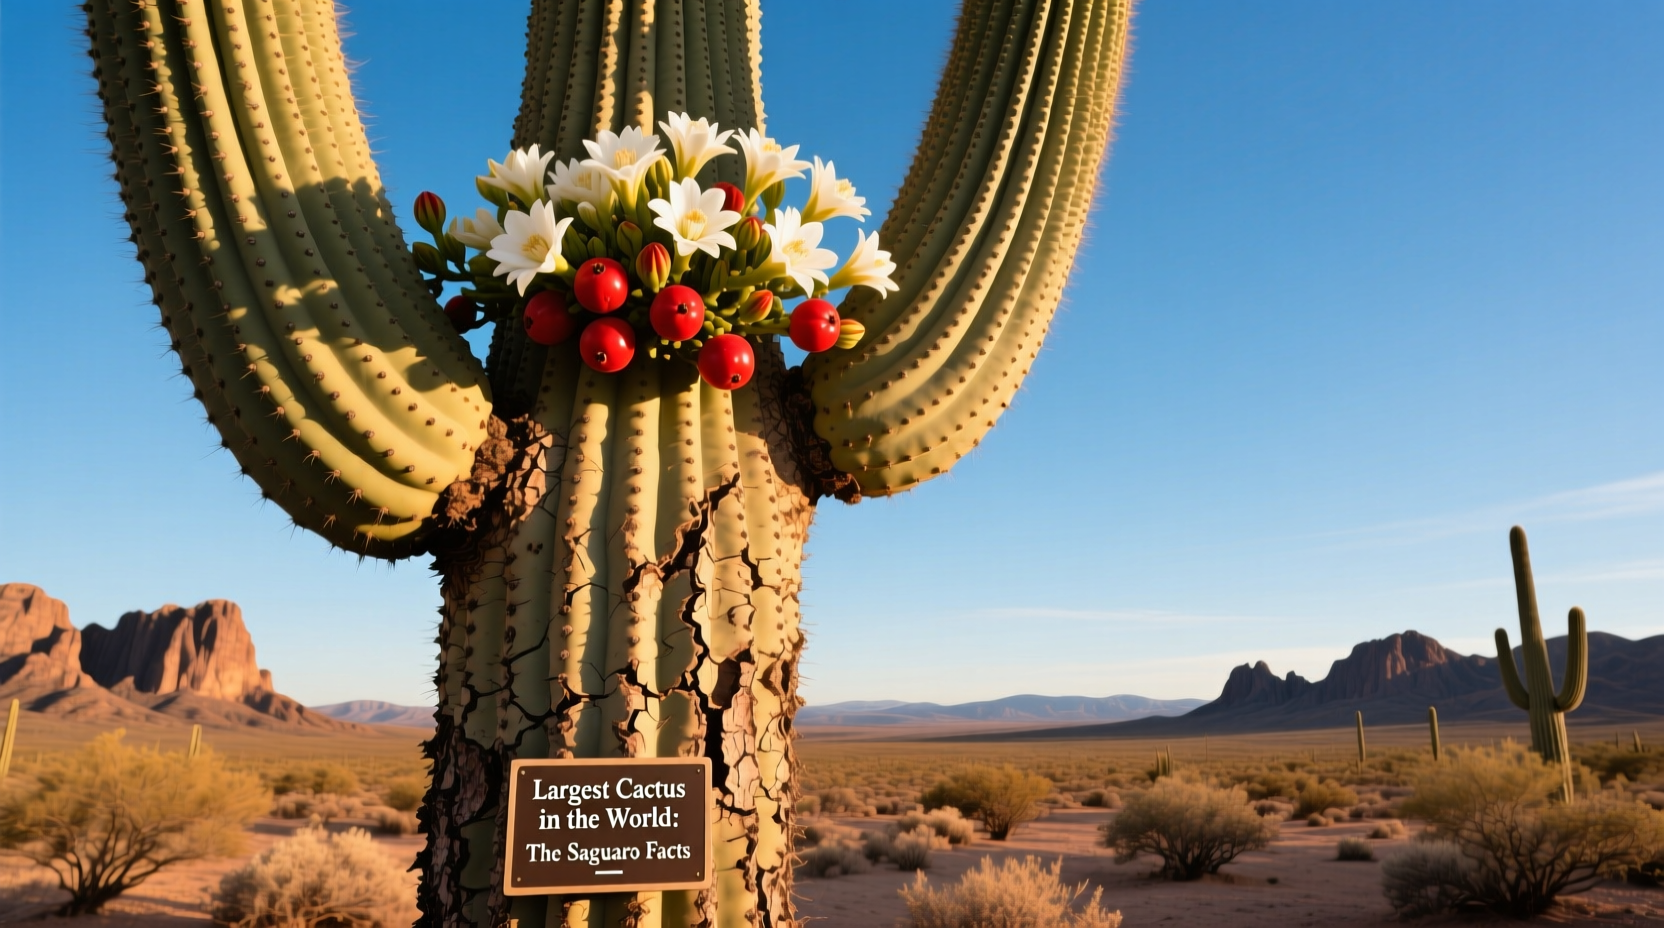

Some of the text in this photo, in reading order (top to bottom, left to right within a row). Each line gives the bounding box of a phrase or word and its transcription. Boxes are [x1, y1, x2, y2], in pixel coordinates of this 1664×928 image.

[532, 777, 686, 806] Largest Cactus
[538, 806, 679, 830] in the World:
[526, 841, 691, 866] The Saguaro Facts
